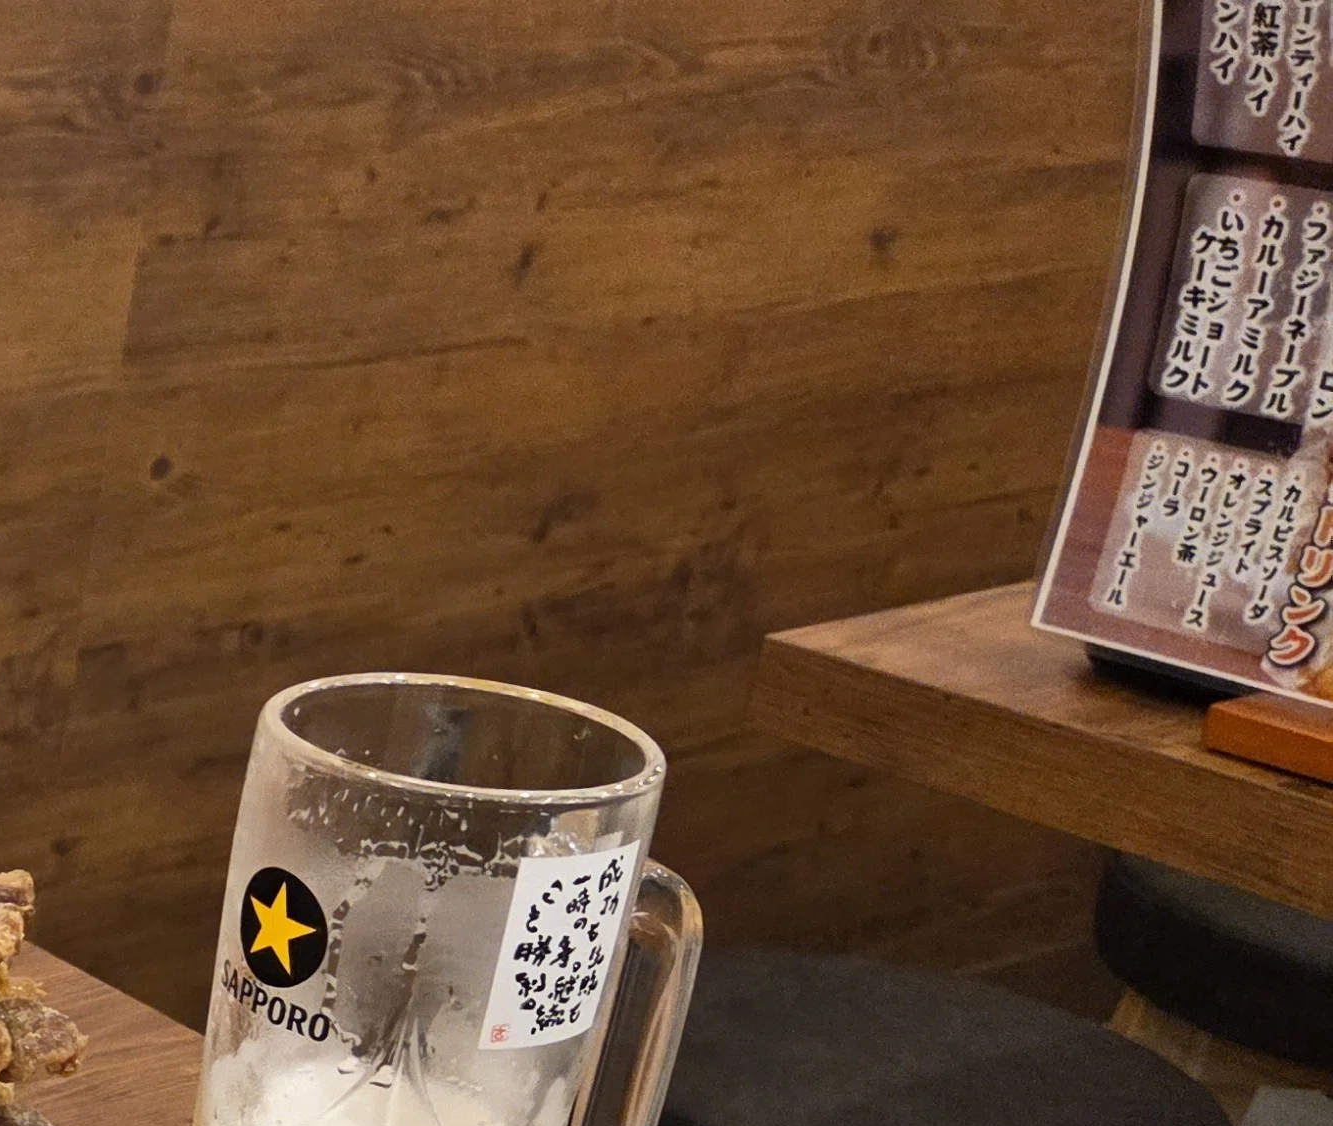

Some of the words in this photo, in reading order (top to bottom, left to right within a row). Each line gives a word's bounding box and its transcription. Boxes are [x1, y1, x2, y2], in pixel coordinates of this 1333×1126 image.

[1248, 2, 1282, 112] 紅茶ハイ
[1283, 0, 1317, 151] ーンティーハイ
[1226, 215, 1284, 402] カルーアミルク
[1266, 221, 1328, 413] ファジーネーブル
[1107, 454, 1165, 606] ジンジャーエール
[1162, 460, 1191, 518] コーラ
[1177, 466, 1219, 564] ウーロン茶
[1186, 473, 1247, 629] オレンジジュース
[1235, 479, 1275, 575] スプライト
[1248, 484, 1303, 621] カルピスソーダ
[220, 957, 332, 1044] SAPPORO
